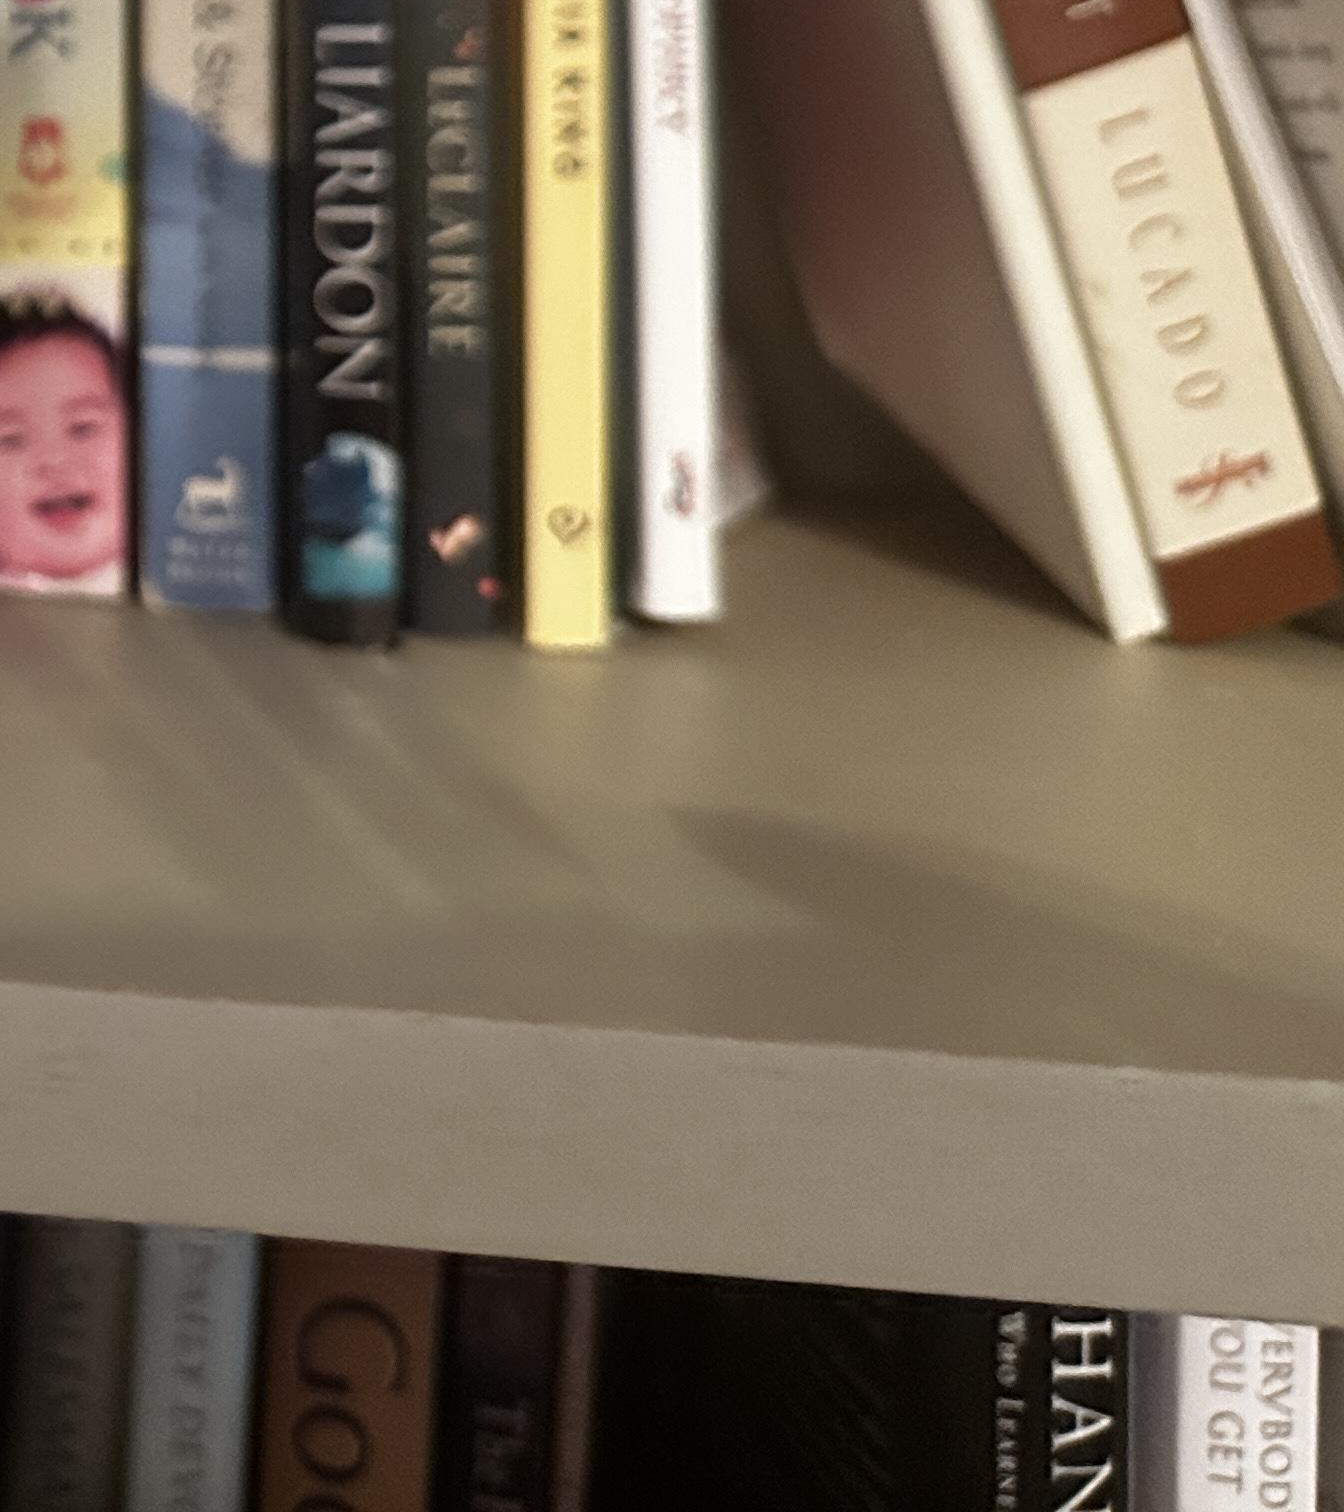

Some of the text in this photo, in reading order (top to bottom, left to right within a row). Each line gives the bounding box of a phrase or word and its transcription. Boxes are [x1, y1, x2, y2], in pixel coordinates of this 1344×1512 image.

[313, 21, 394, 403] LIARDON
[550, 65, 588, 183] KING
[1098, 107, 1232, 412] LUCADO
[291, 1296, 414, 1512] Go
[1205, 1409, 1246, 1495] GET
